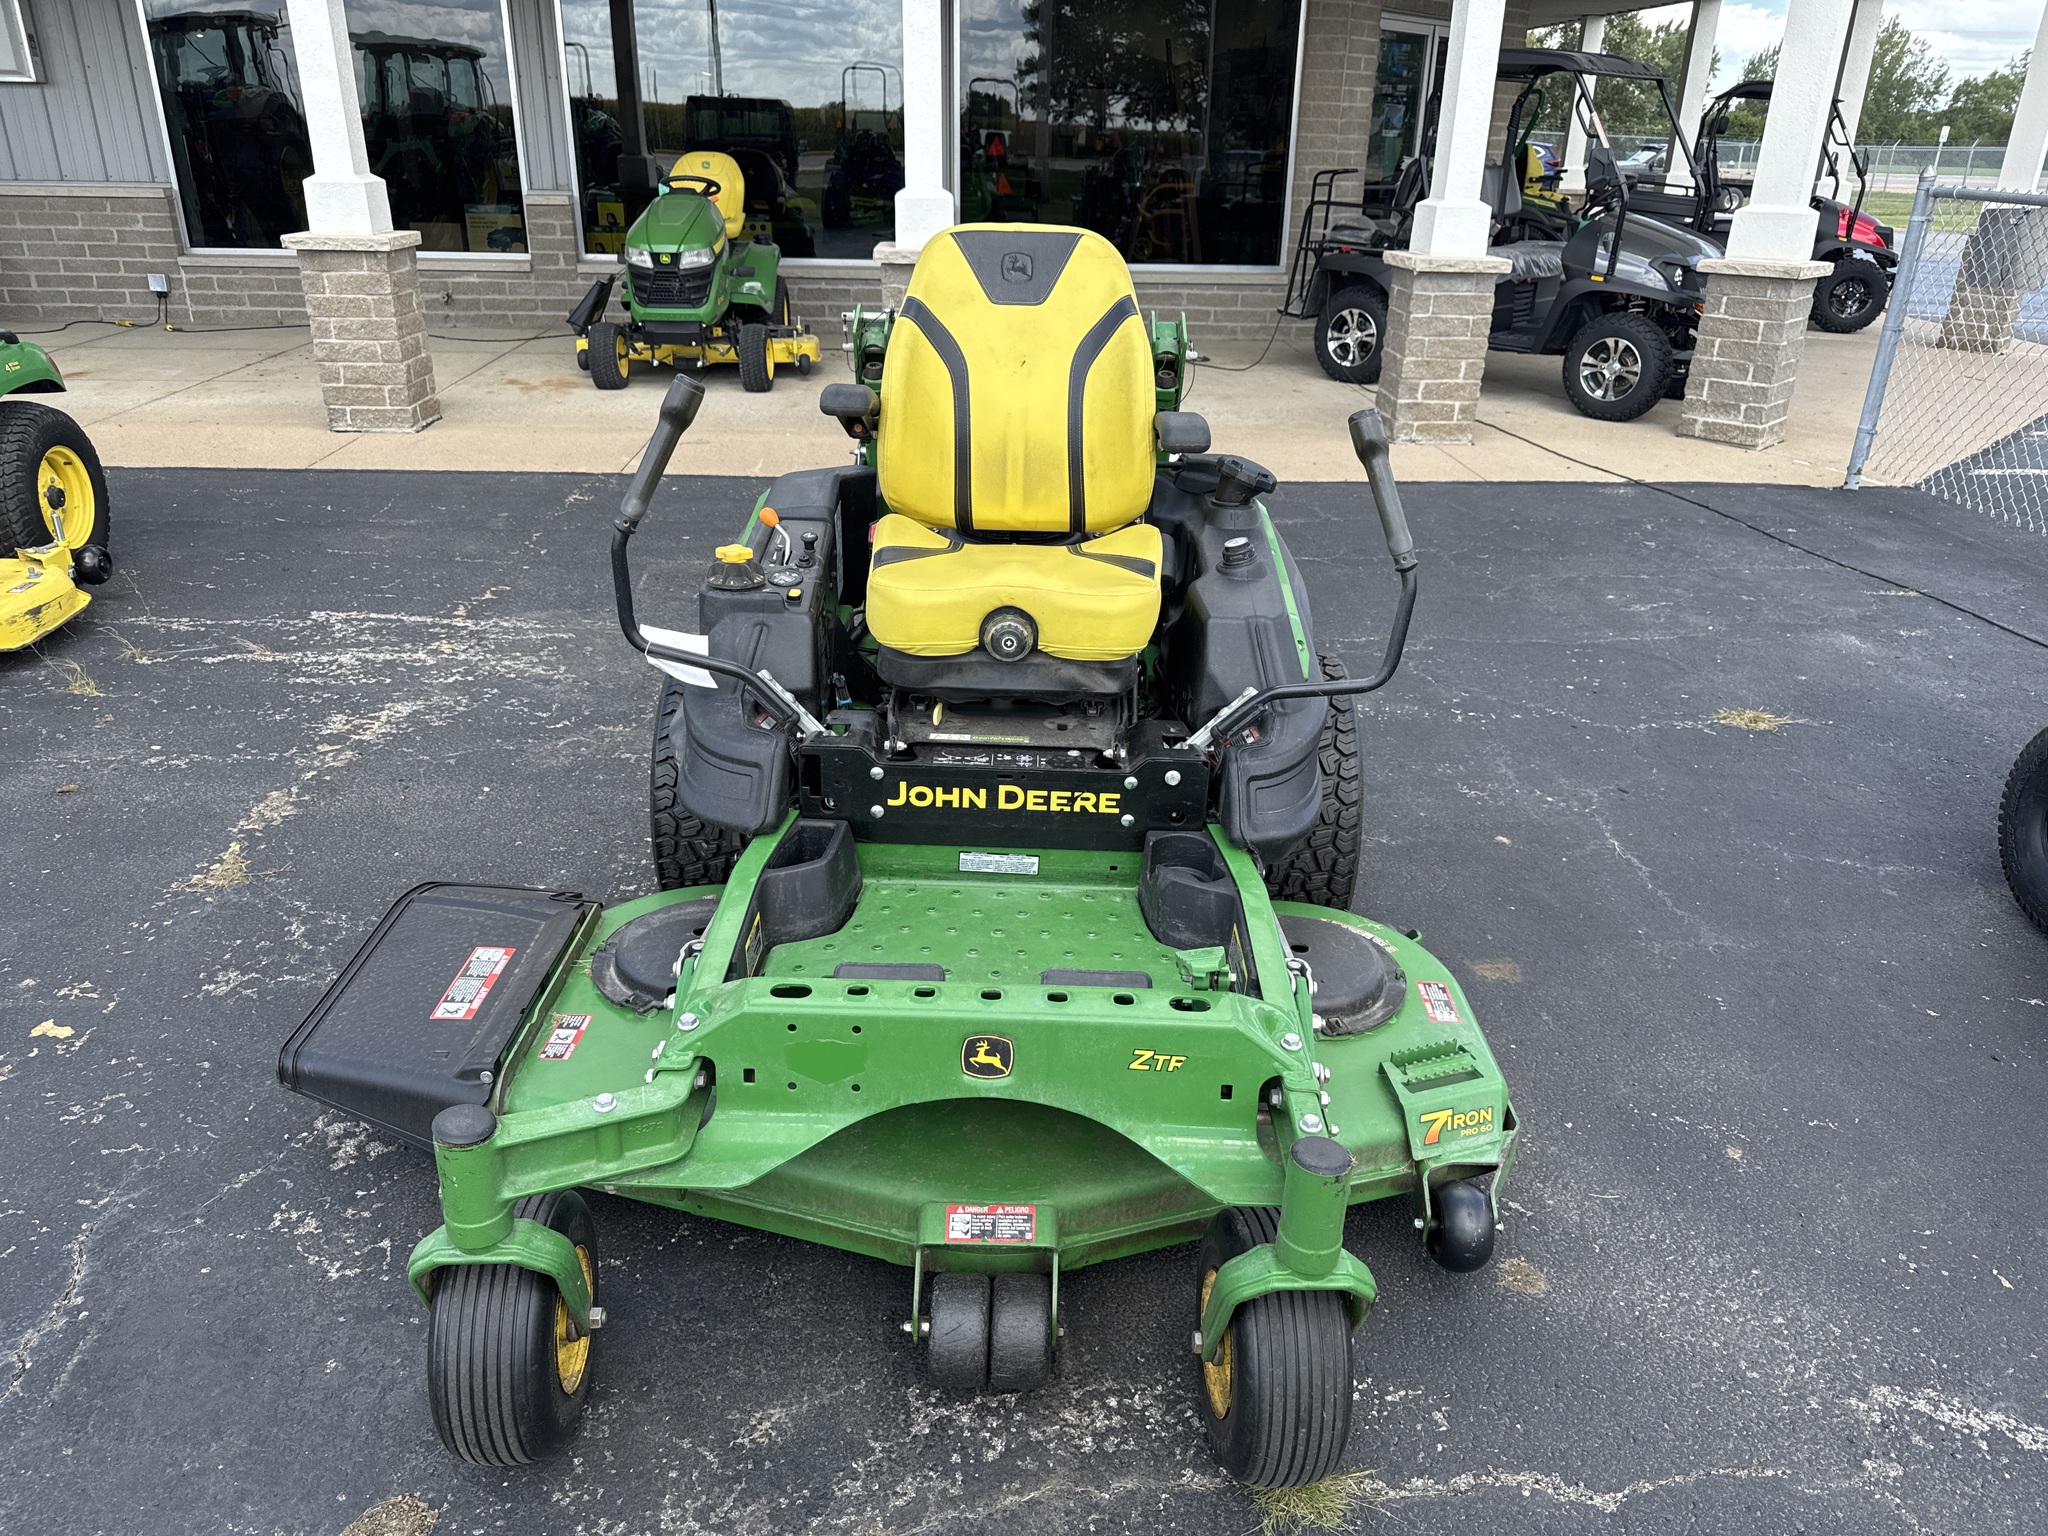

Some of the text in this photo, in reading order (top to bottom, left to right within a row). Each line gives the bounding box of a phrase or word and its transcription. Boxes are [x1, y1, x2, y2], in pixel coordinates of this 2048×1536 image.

[887, 781, 1121, 813] JOHN DEERE
[1461, 1124, 1493, 1138] PRO 60
